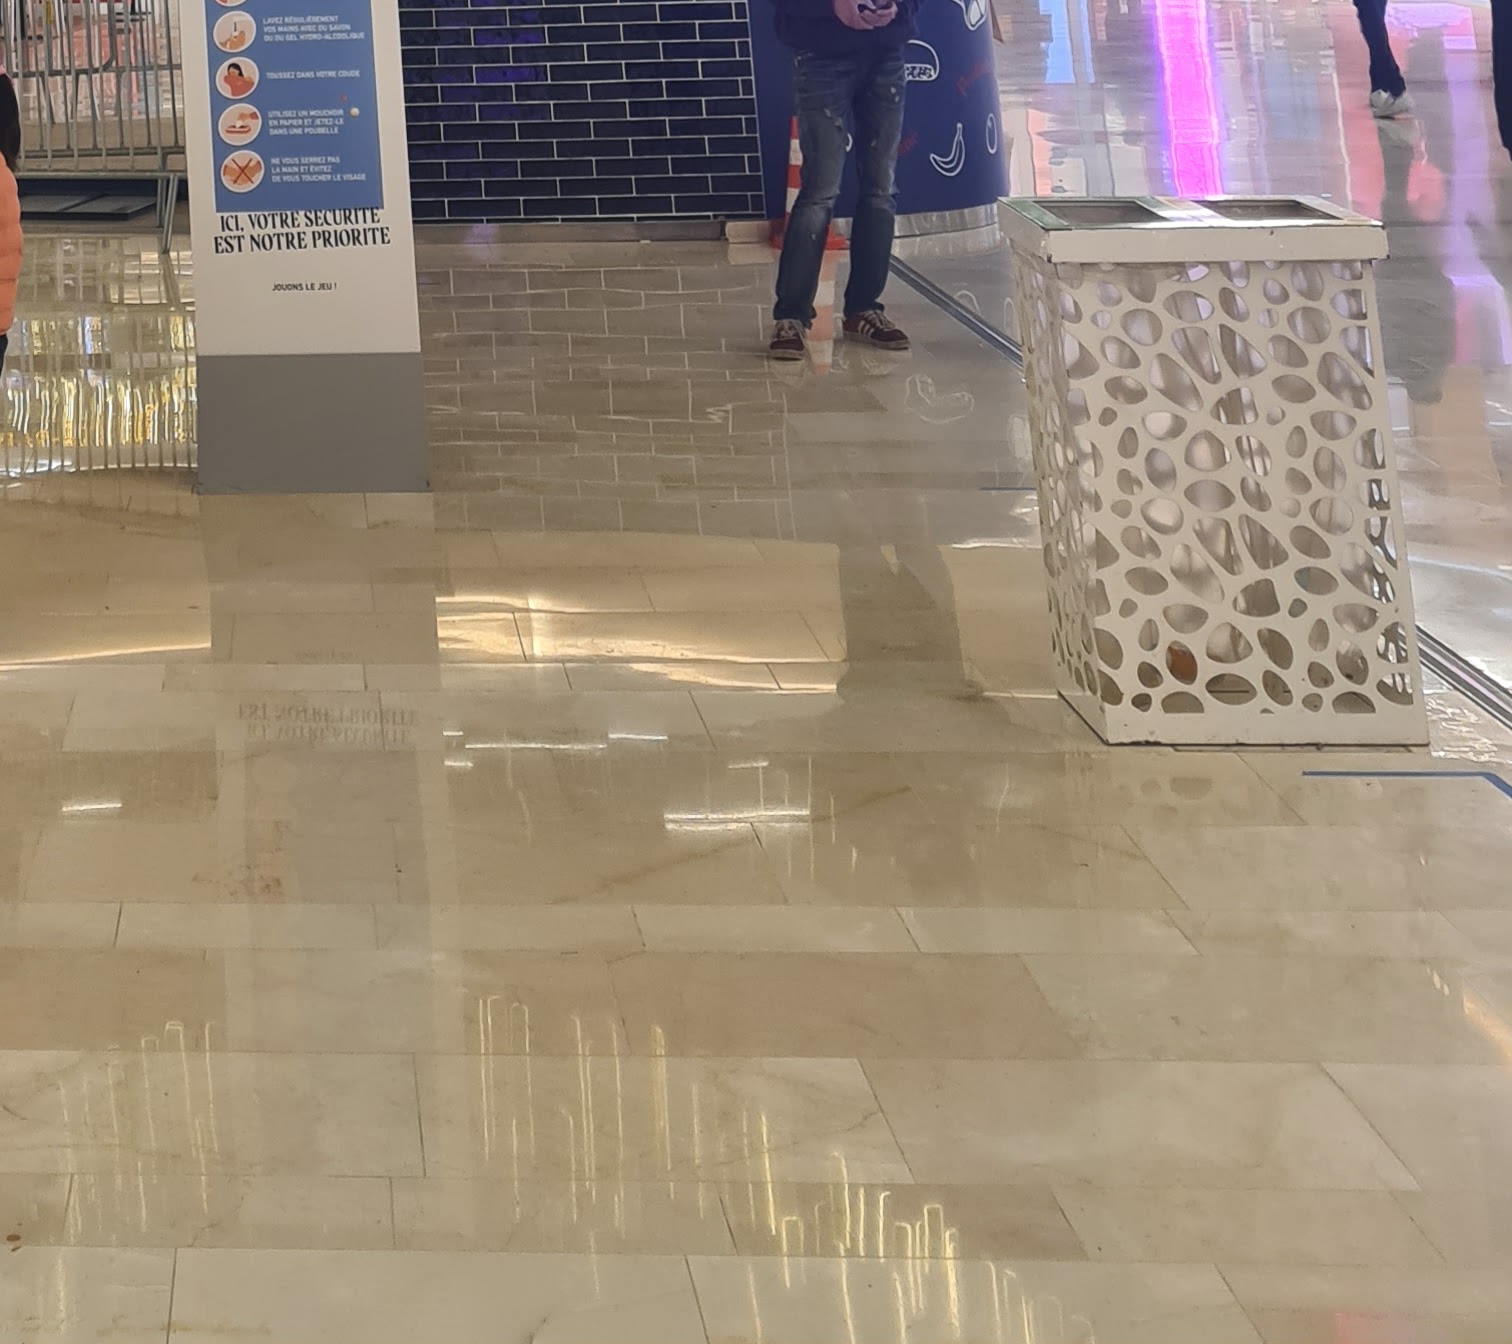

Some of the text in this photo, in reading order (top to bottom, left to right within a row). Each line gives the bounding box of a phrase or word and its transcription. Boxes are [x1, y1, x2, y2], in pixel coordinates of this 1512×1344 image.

[220, 214, 244, 232] ICI,
[248, 211, 300, 230] VOTRE
[214, 226, 391, 254] EST NOTRE PRIORITE
[272, 283, 303, 292] JOUONS
[306, 282, 315, 291] LE
[318, 282, 332, 291] JEU
